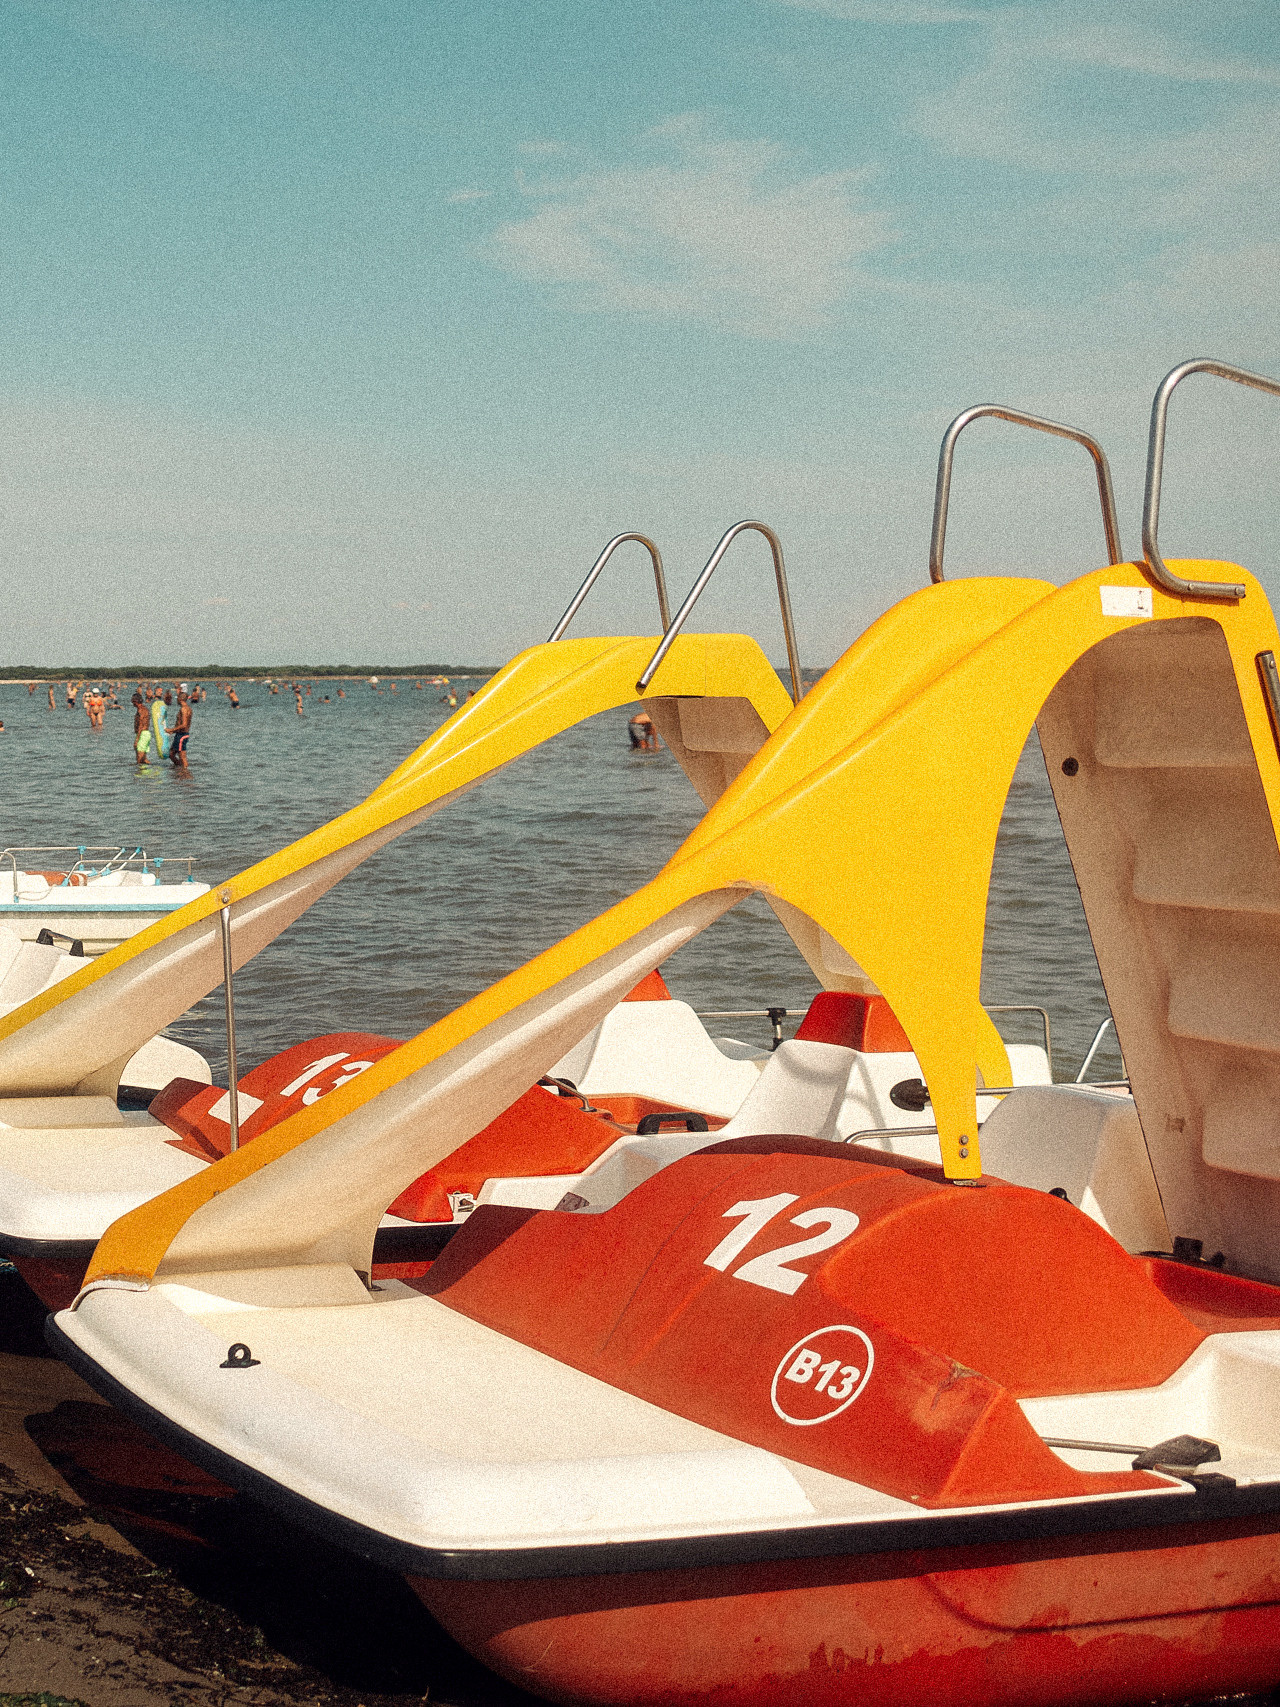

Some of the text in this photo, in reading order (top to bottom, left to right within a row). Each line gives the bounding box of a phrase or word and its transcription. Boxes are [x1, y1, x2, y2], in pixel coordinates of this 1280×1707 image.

[279, 1052, 375, 1106] 13
[702, 1192, 860, 1296] 12
[784, 1348, 861, 1400] B13
